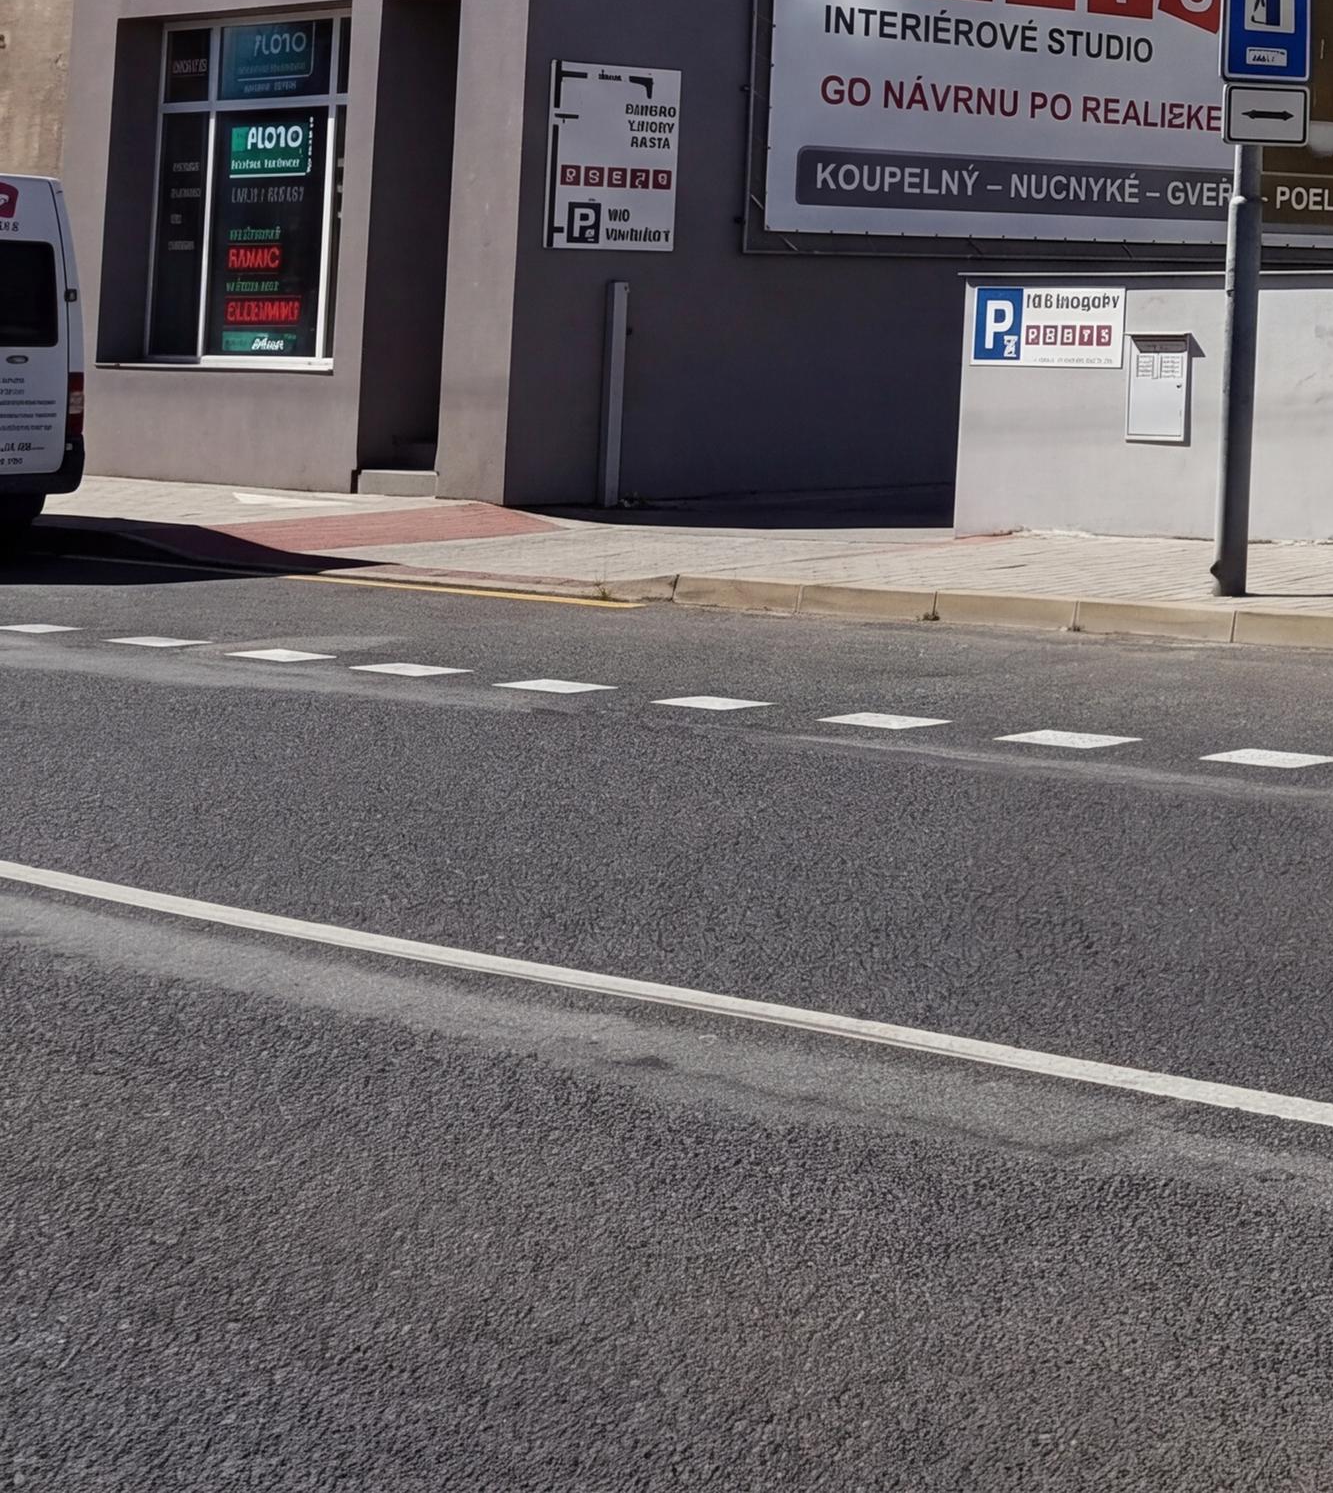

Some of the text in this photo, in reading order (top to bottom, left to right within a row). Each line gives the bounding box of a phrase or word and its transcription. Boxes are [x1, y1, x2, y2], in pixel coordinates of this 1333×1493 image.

[824, 4, 1154, 64] INTERIÉROVÉ STUDIO
[1030, 91, 1072, 121] PO
